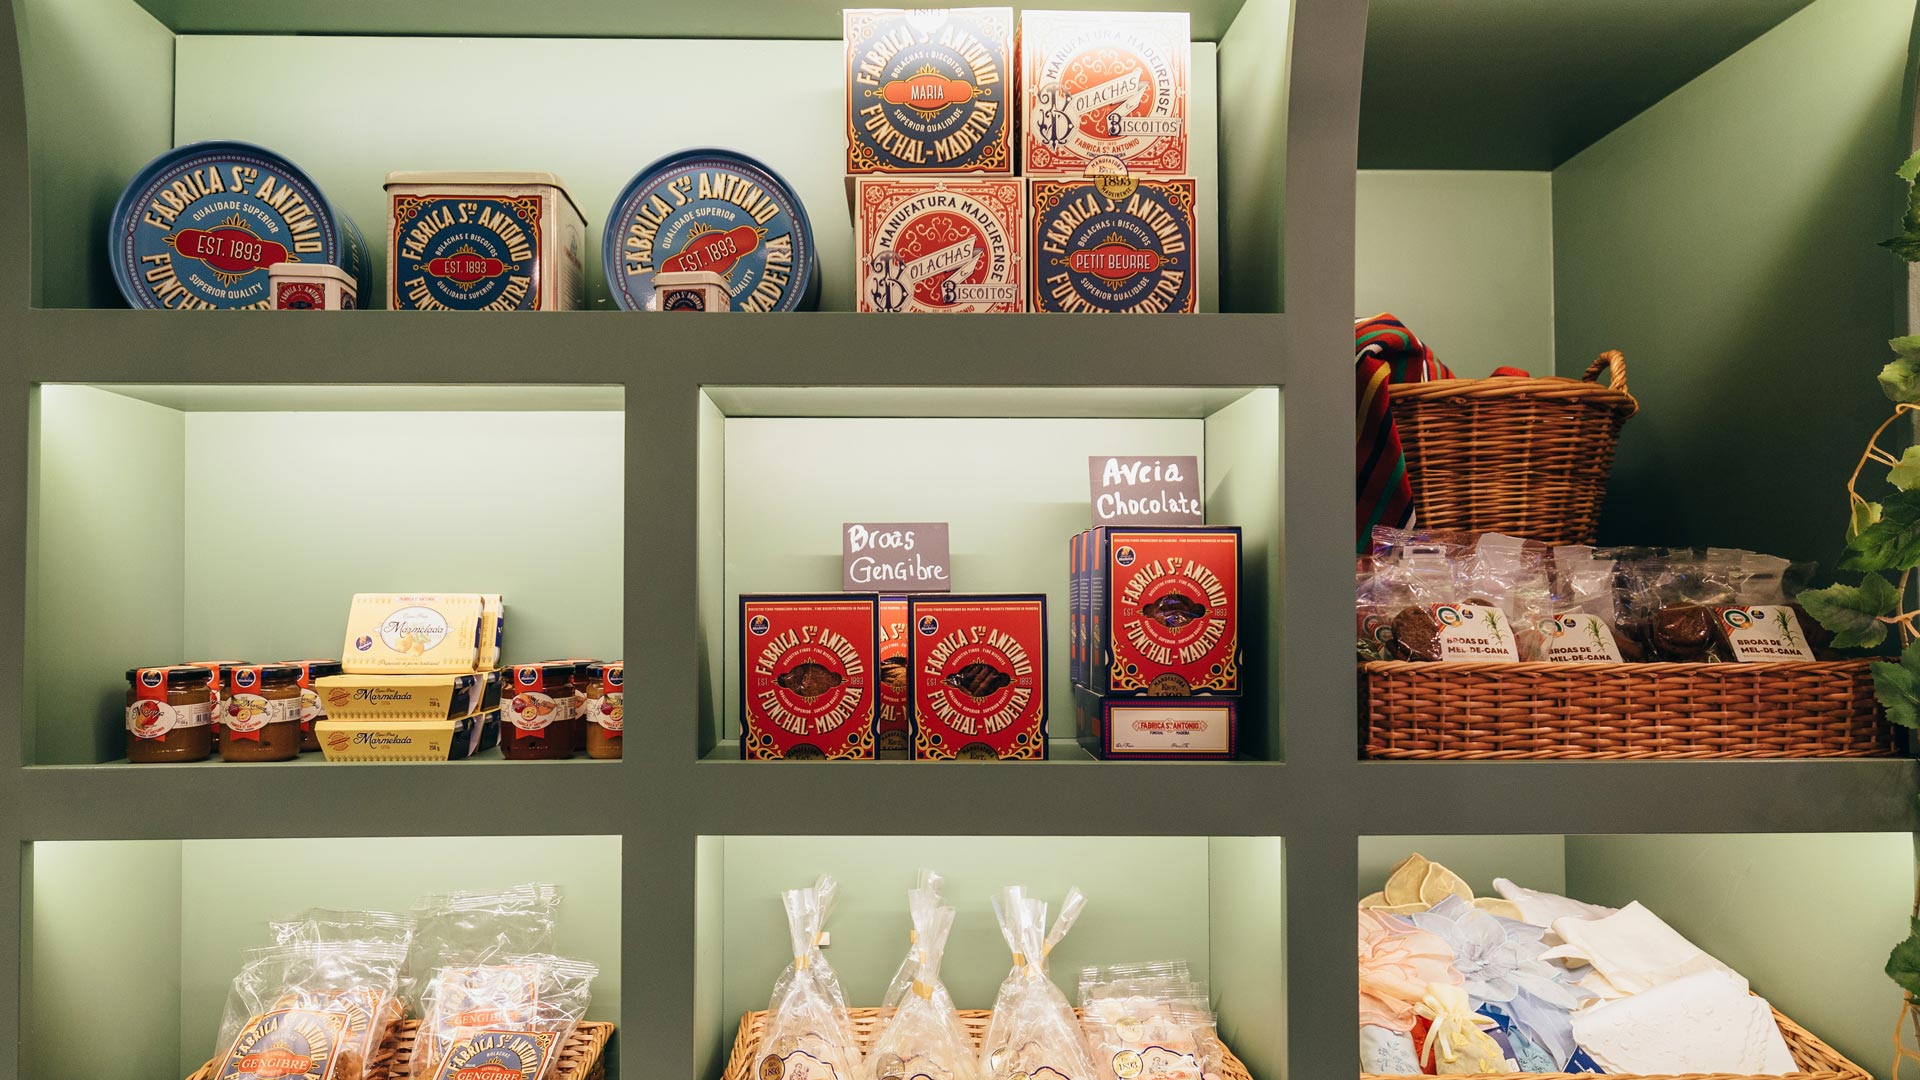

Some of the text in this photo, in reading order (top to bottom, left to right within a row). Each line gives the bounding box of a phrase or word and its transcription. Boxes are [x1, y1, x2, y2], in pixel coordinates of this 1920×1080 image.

[891, 51, 924, 79] BOLACHAS
[931, 51, 965, 78] BISCOITOS
[1127, 34, 1171, 116] MADEIRENSE
[911, 84, 944, 101] MARIA
[893, 107, 964, 133] SUPERIOR QUALIDADE
[1091, 158, 1123, 171] MANUFATURA
[1100, 186, 1132, 197] MADEIRENSE
[192, 201, 279, 234] QUALIDADE SUPERIOR
[662, 207, 736, 249] QUALIDADE SUPERIOR
[434, 233, 464, 256] BOLACHAS
[470, 233, 498, 257] BISCOITOS
[879, 195, 1006, 282] MANUFATURA MADEIRENSE
[1077, 219, 1111, 247] BOLACHAS
[1117, 219, 1152, 247] BISCOITOS
[197, 235, 262, 262] EST. 1893
[678, 236, 737, 272] EST. 1893
[465, 261, 487, 273] 1893
[1076, 254, 1151, 270] PETIT BEURRE
[189, 273, 263, 299] SUPERIOR QUALITY
[436, 280, 496, 300] QUALIDADE SUPERIOR
[730, 268, 755, 297] QUALITY
[1080, 276, 1151, 301] SUPERIOR QUALIDADE
[1097, 489, 1201, 519] Chocolate
[848, 524, 915, 553] Broas
[1214, 608, 1228, 616] 1893
[383, 621, 443, 638] Marmelada
[850, 677, 864, 685] 1893
[1019, 677, 1033, 685] 1893
[353, 688, 412, 705] Marmelada
[353, 732, 412, 749] Marmelada
[241, 1058, 309, 1070] GENGIBRE
